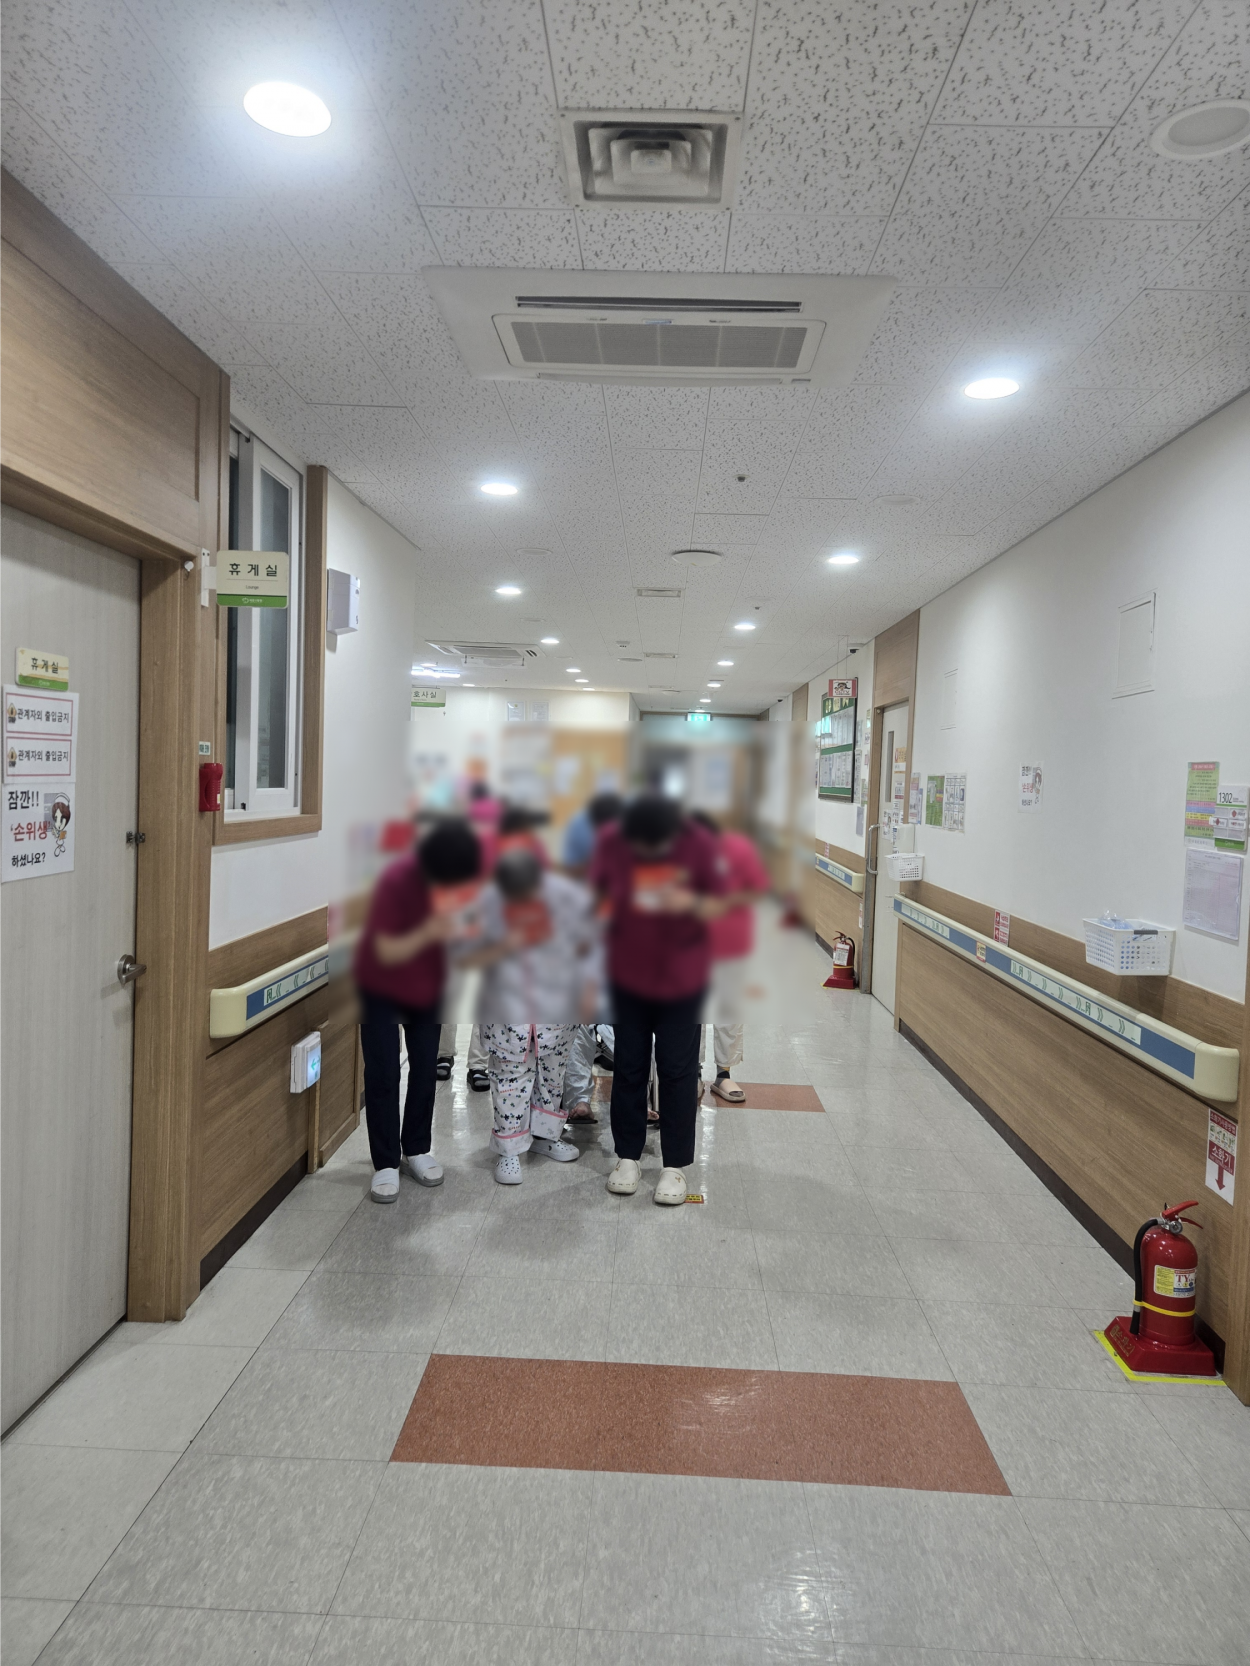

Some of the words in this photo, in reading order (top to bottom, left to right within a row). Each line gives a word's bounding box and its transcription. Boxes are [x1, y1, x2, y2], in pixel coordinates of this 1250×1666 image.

[17, 708, 43, 722] 관계자외
[44, 710, 70, 723] 출입금지
[17, 749, 43, 761] 관계자외
[44, 750, 69, 762] 출입금지
[8, 790, 39, 811] 잠깐!!
[1218, 792, 1233, 804] 1302
[11, 852, 46, 868] 하셨나요?
[1211, 1145, 1232, 1168] 소화기
